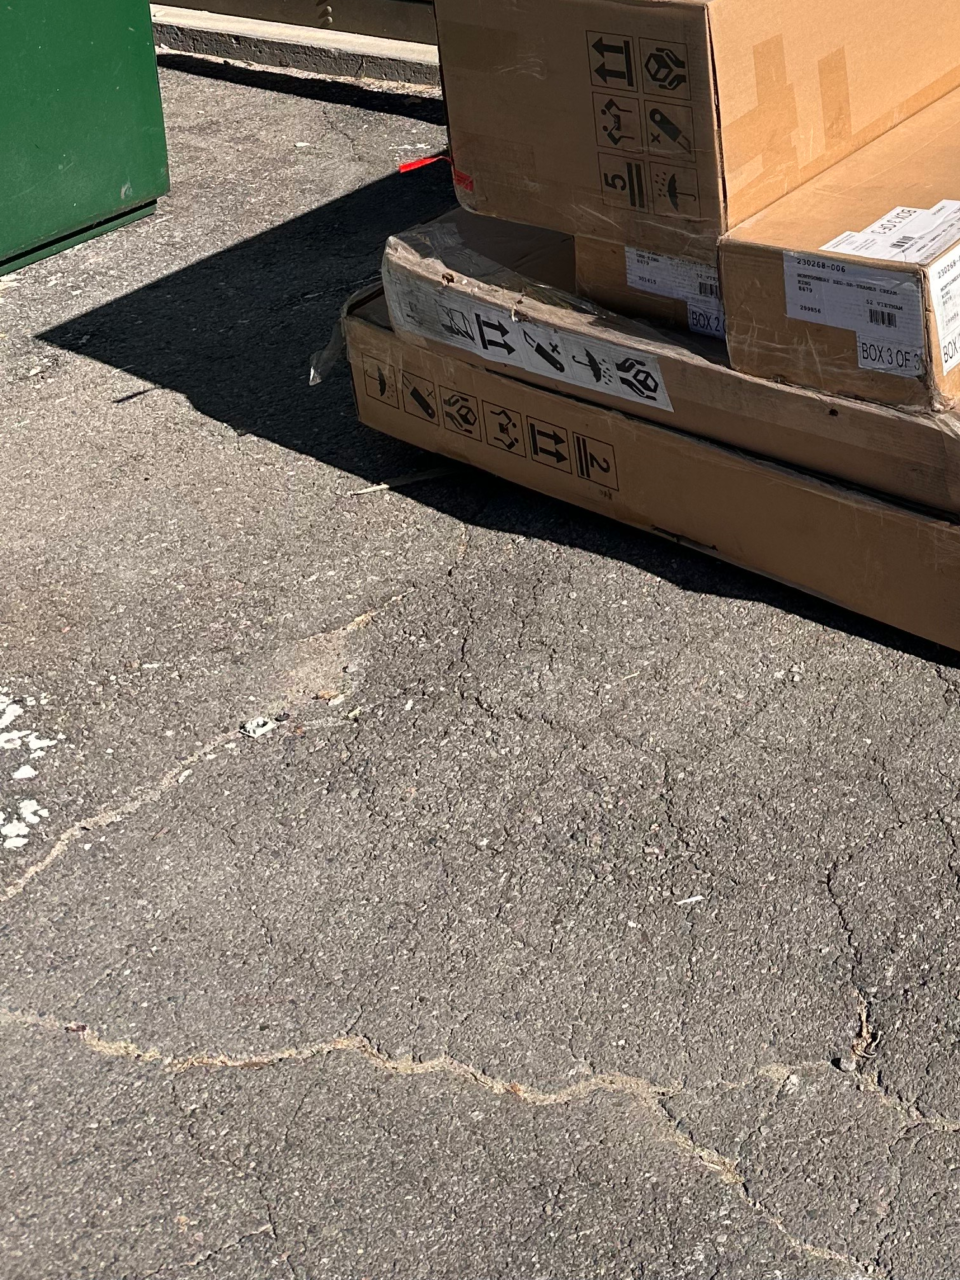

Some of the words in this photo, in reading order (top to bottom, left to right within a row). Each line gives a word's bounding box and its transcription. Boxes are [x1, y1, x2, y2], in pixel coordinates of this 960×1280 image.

[604, 172, 627, 192] 5
[797, 258, 846, 273] 230268-006
[691, 311, 712, 331] BOX
[714, 316, 721, 332] 2
[861, 342, 885, 364] BOX
[886, 347, 894, 365] 3
[896, 349, 911, 368] OF
[942, 338, 958, 364] BOX
[588, 451, 611, 473] 2
